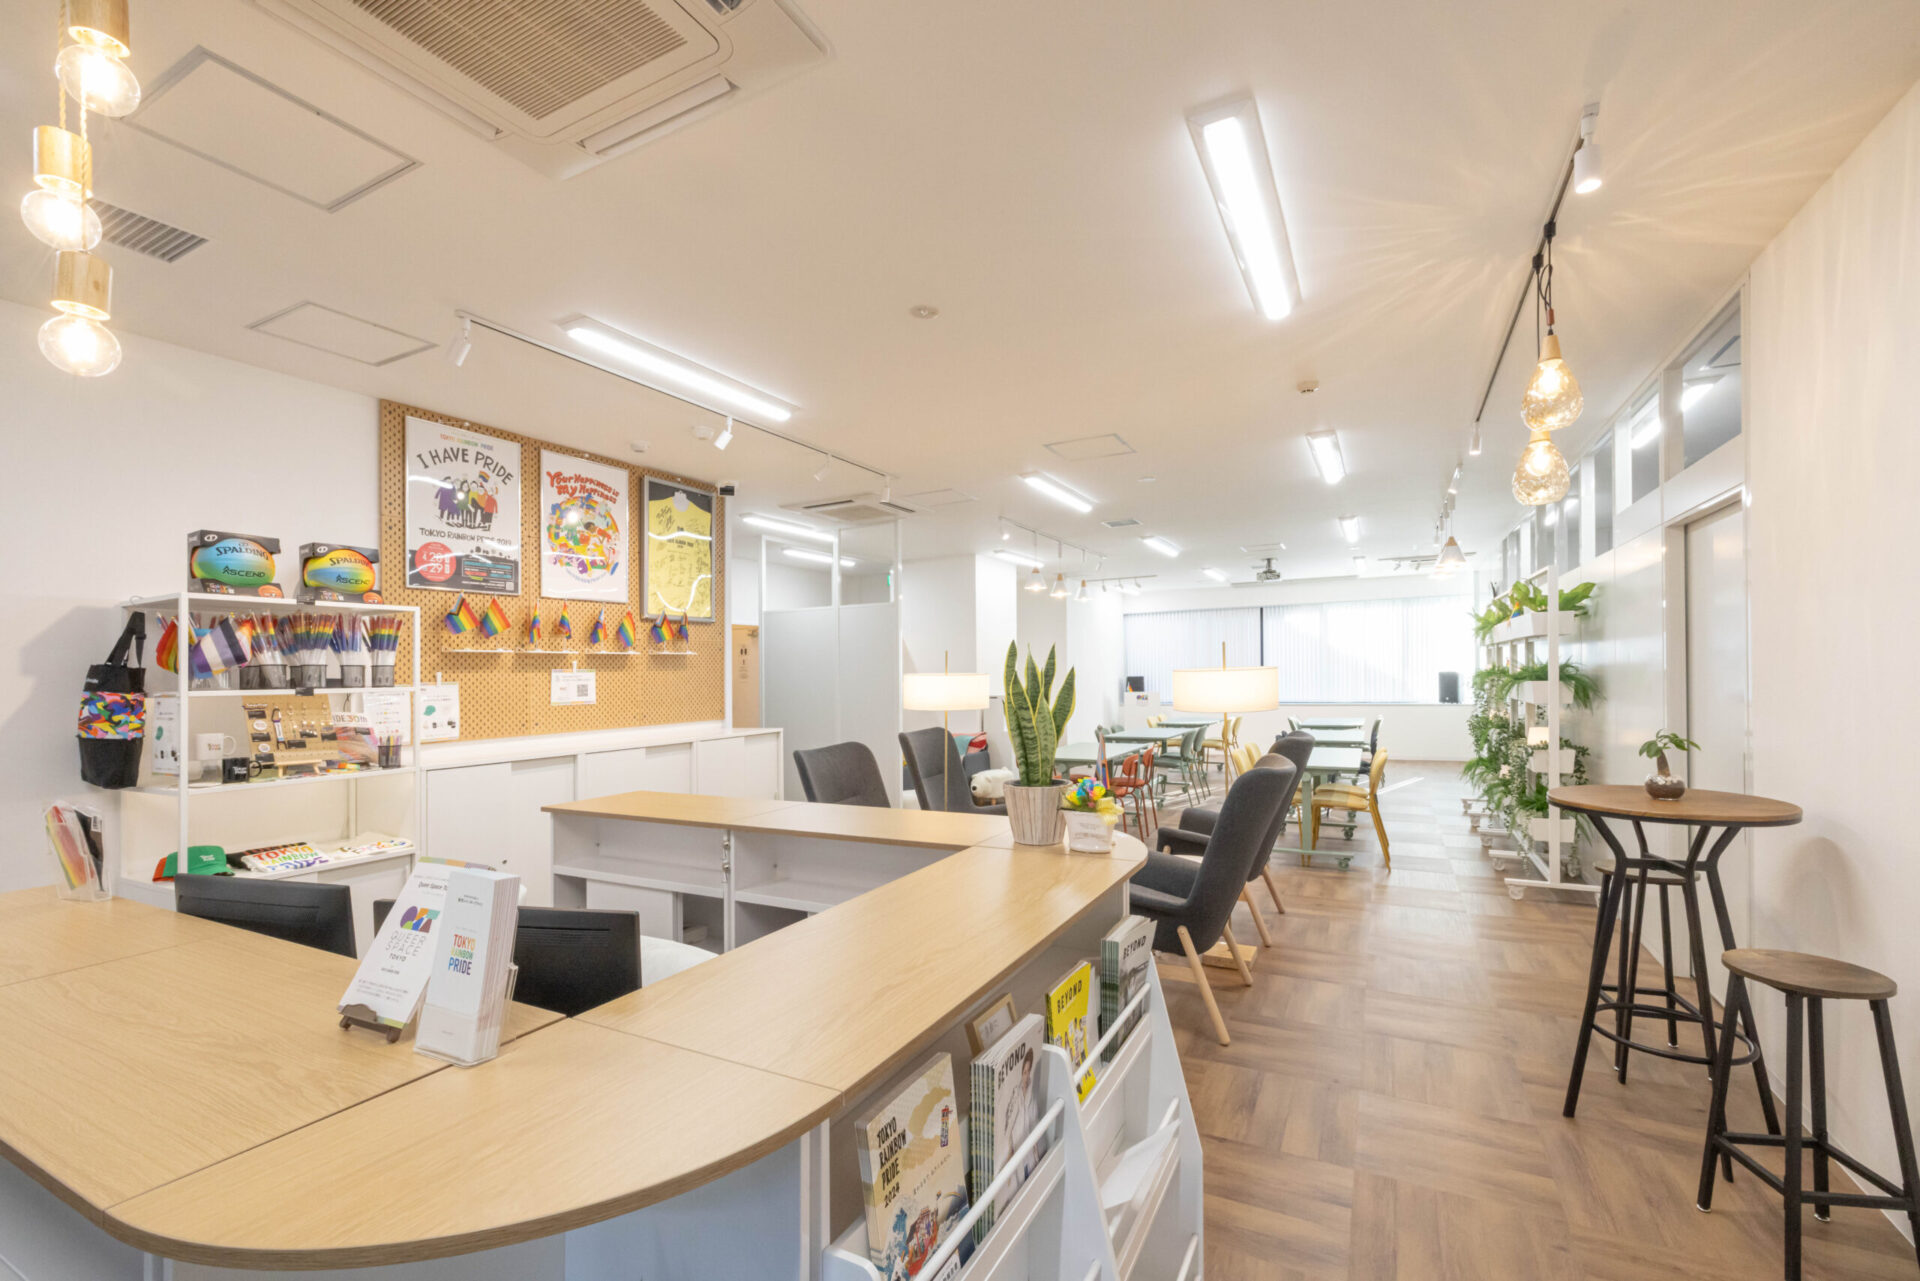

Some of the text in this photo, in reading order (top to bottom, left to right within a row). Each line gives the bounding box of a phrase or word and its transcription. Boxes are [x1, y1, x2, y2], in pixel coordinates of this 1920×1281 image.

[416, 447, 514, 485] I HAVE PRIDE
[419, 527, 446, 538] TOKYO
[216, 545, 269, 560] SPALDING
[222, 565, 266, 578] ASCEND
[252, 845, 314, 861] TOKYO
[384, 941, 421, 957] SPACE
[390, 930, 427, 946] QUEER
[453, 933, 477, 952] TOKYO
[1123, 935, 1147, 960] BEYOND
[447, 956, 473, 976] PRIDE
[1057, 980, 1083, 1014] BEYOND
[997, 1042, 1027, 1091] BEYOND
[877, 1116, 897, 1148] TOKYO
[879, 1128, 907, 1170] RAINBOW
[881, 1157, 900, 1191] PRIDE
[884, 1182, 900, 1209] 2024
